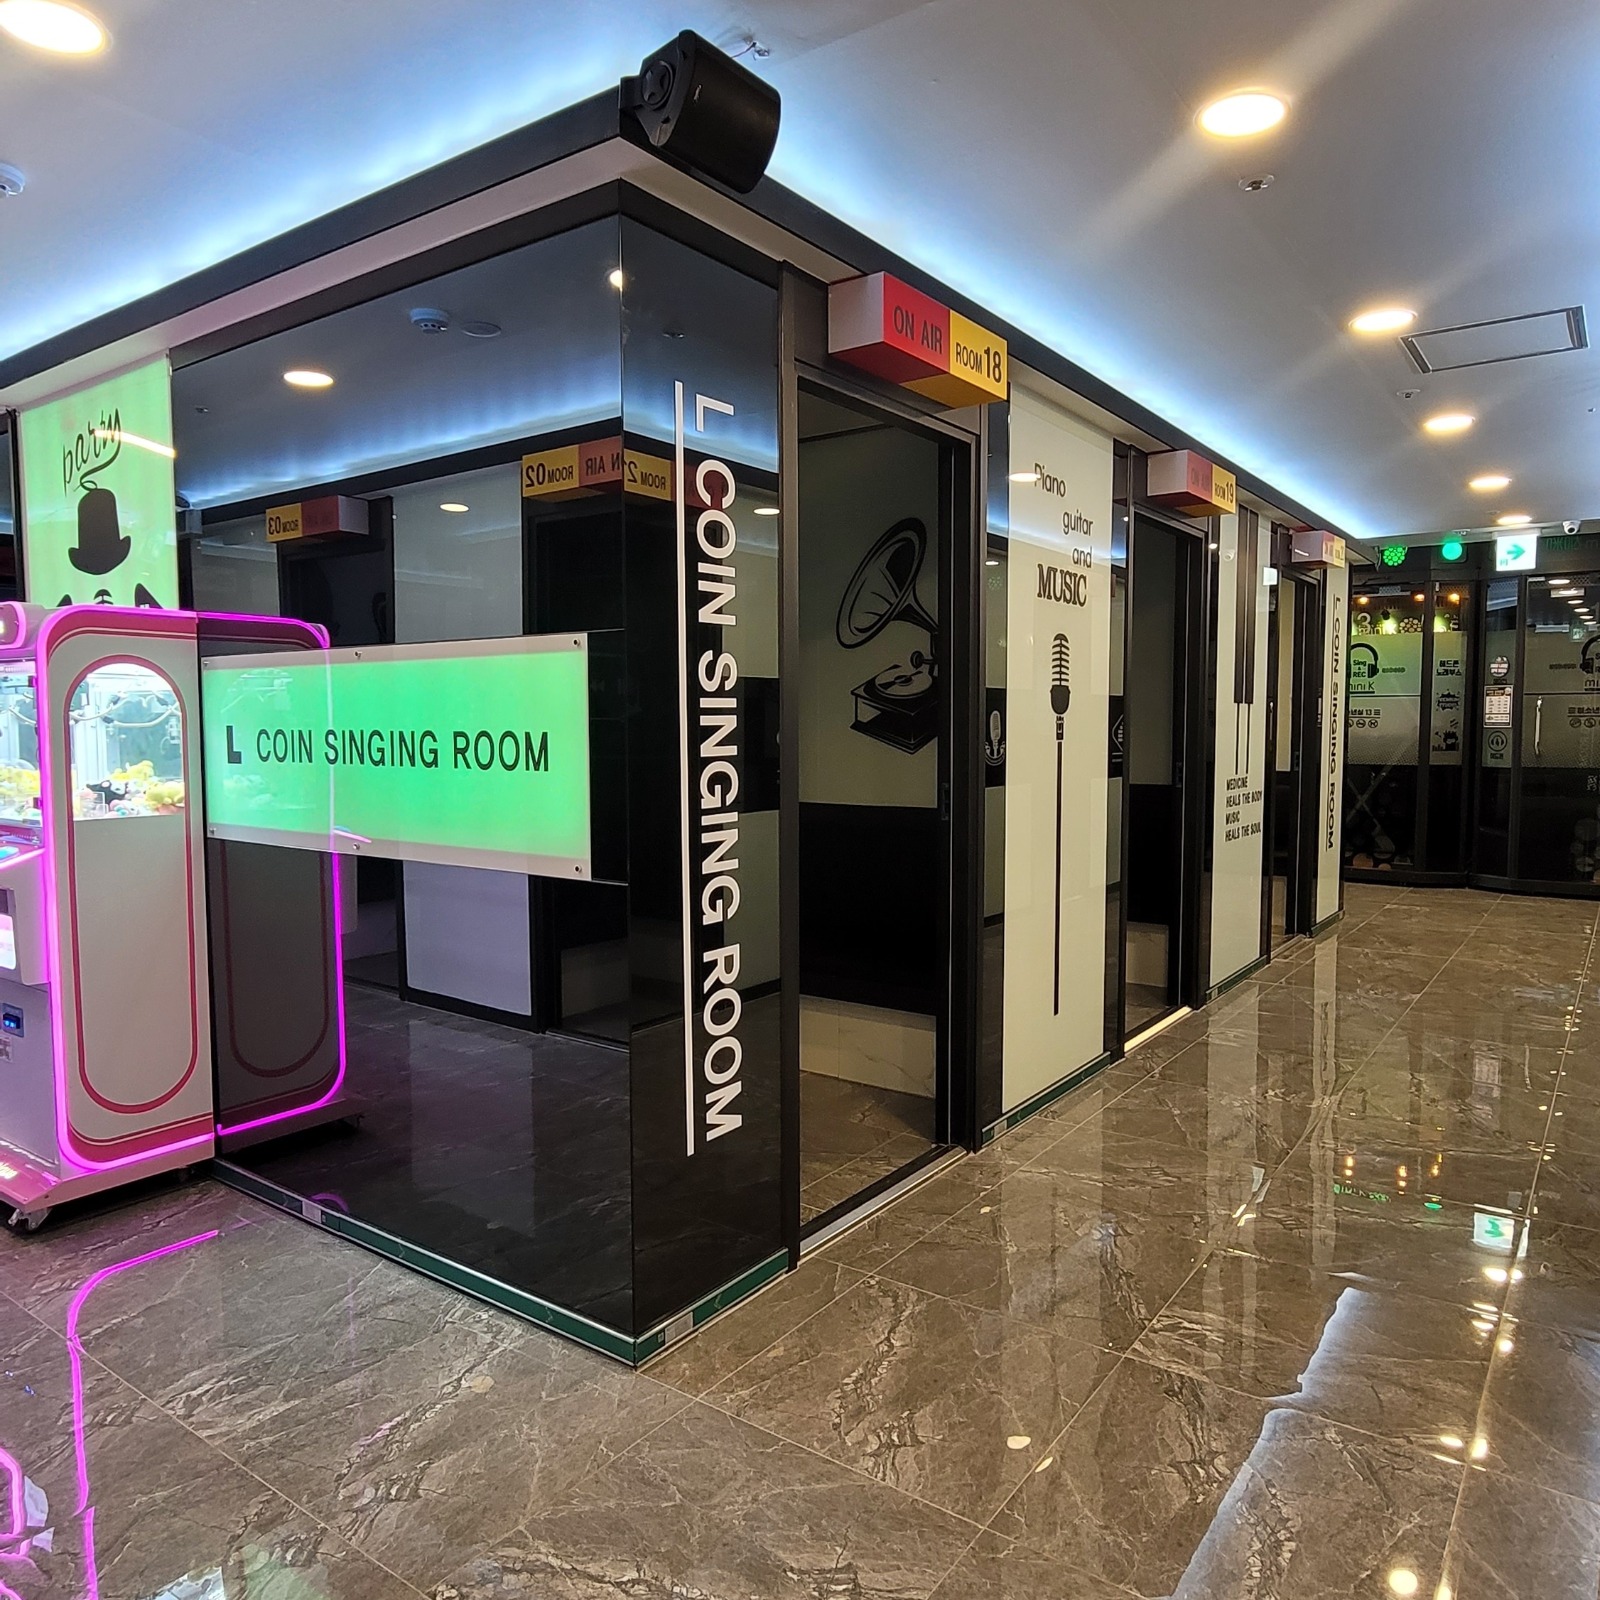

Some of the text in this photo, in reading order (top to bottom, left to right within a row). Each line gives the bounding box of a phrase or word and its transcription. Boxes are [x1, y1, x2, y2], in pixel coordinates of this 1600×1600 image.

[893, 306, 943, 354] ON AIR
[955, 342, 1002, 384] ROOM 18
[695, 393, 734, 432] L
[1034, 462, 1066, 498] Piano
[1226, 481, 1234, 504] 19
[695, 459, 737, 626] COIN
[1062, 508, 1094, 537] guitar
[1072, 545, 1093, 569] and
[1036, 563, 1087, 608] MUSIC
[1333, 617, 1342, 673] COIN
[1353, 659, 1367, 667] Sing
[1368, 681, 1375, 691] K
[226, 725, 549, 772] L COIN SINGING ROOM
[1330, 682, 1339, 775] SINGING
[698, 650, 740, 924] SINGING
[1242, 791, 1251, 805] THE
[1241, 824, 1250, 838] THE
[1327, 782, 1336, 849] ROOM
[702, 943, 743, 1142] ROOM
